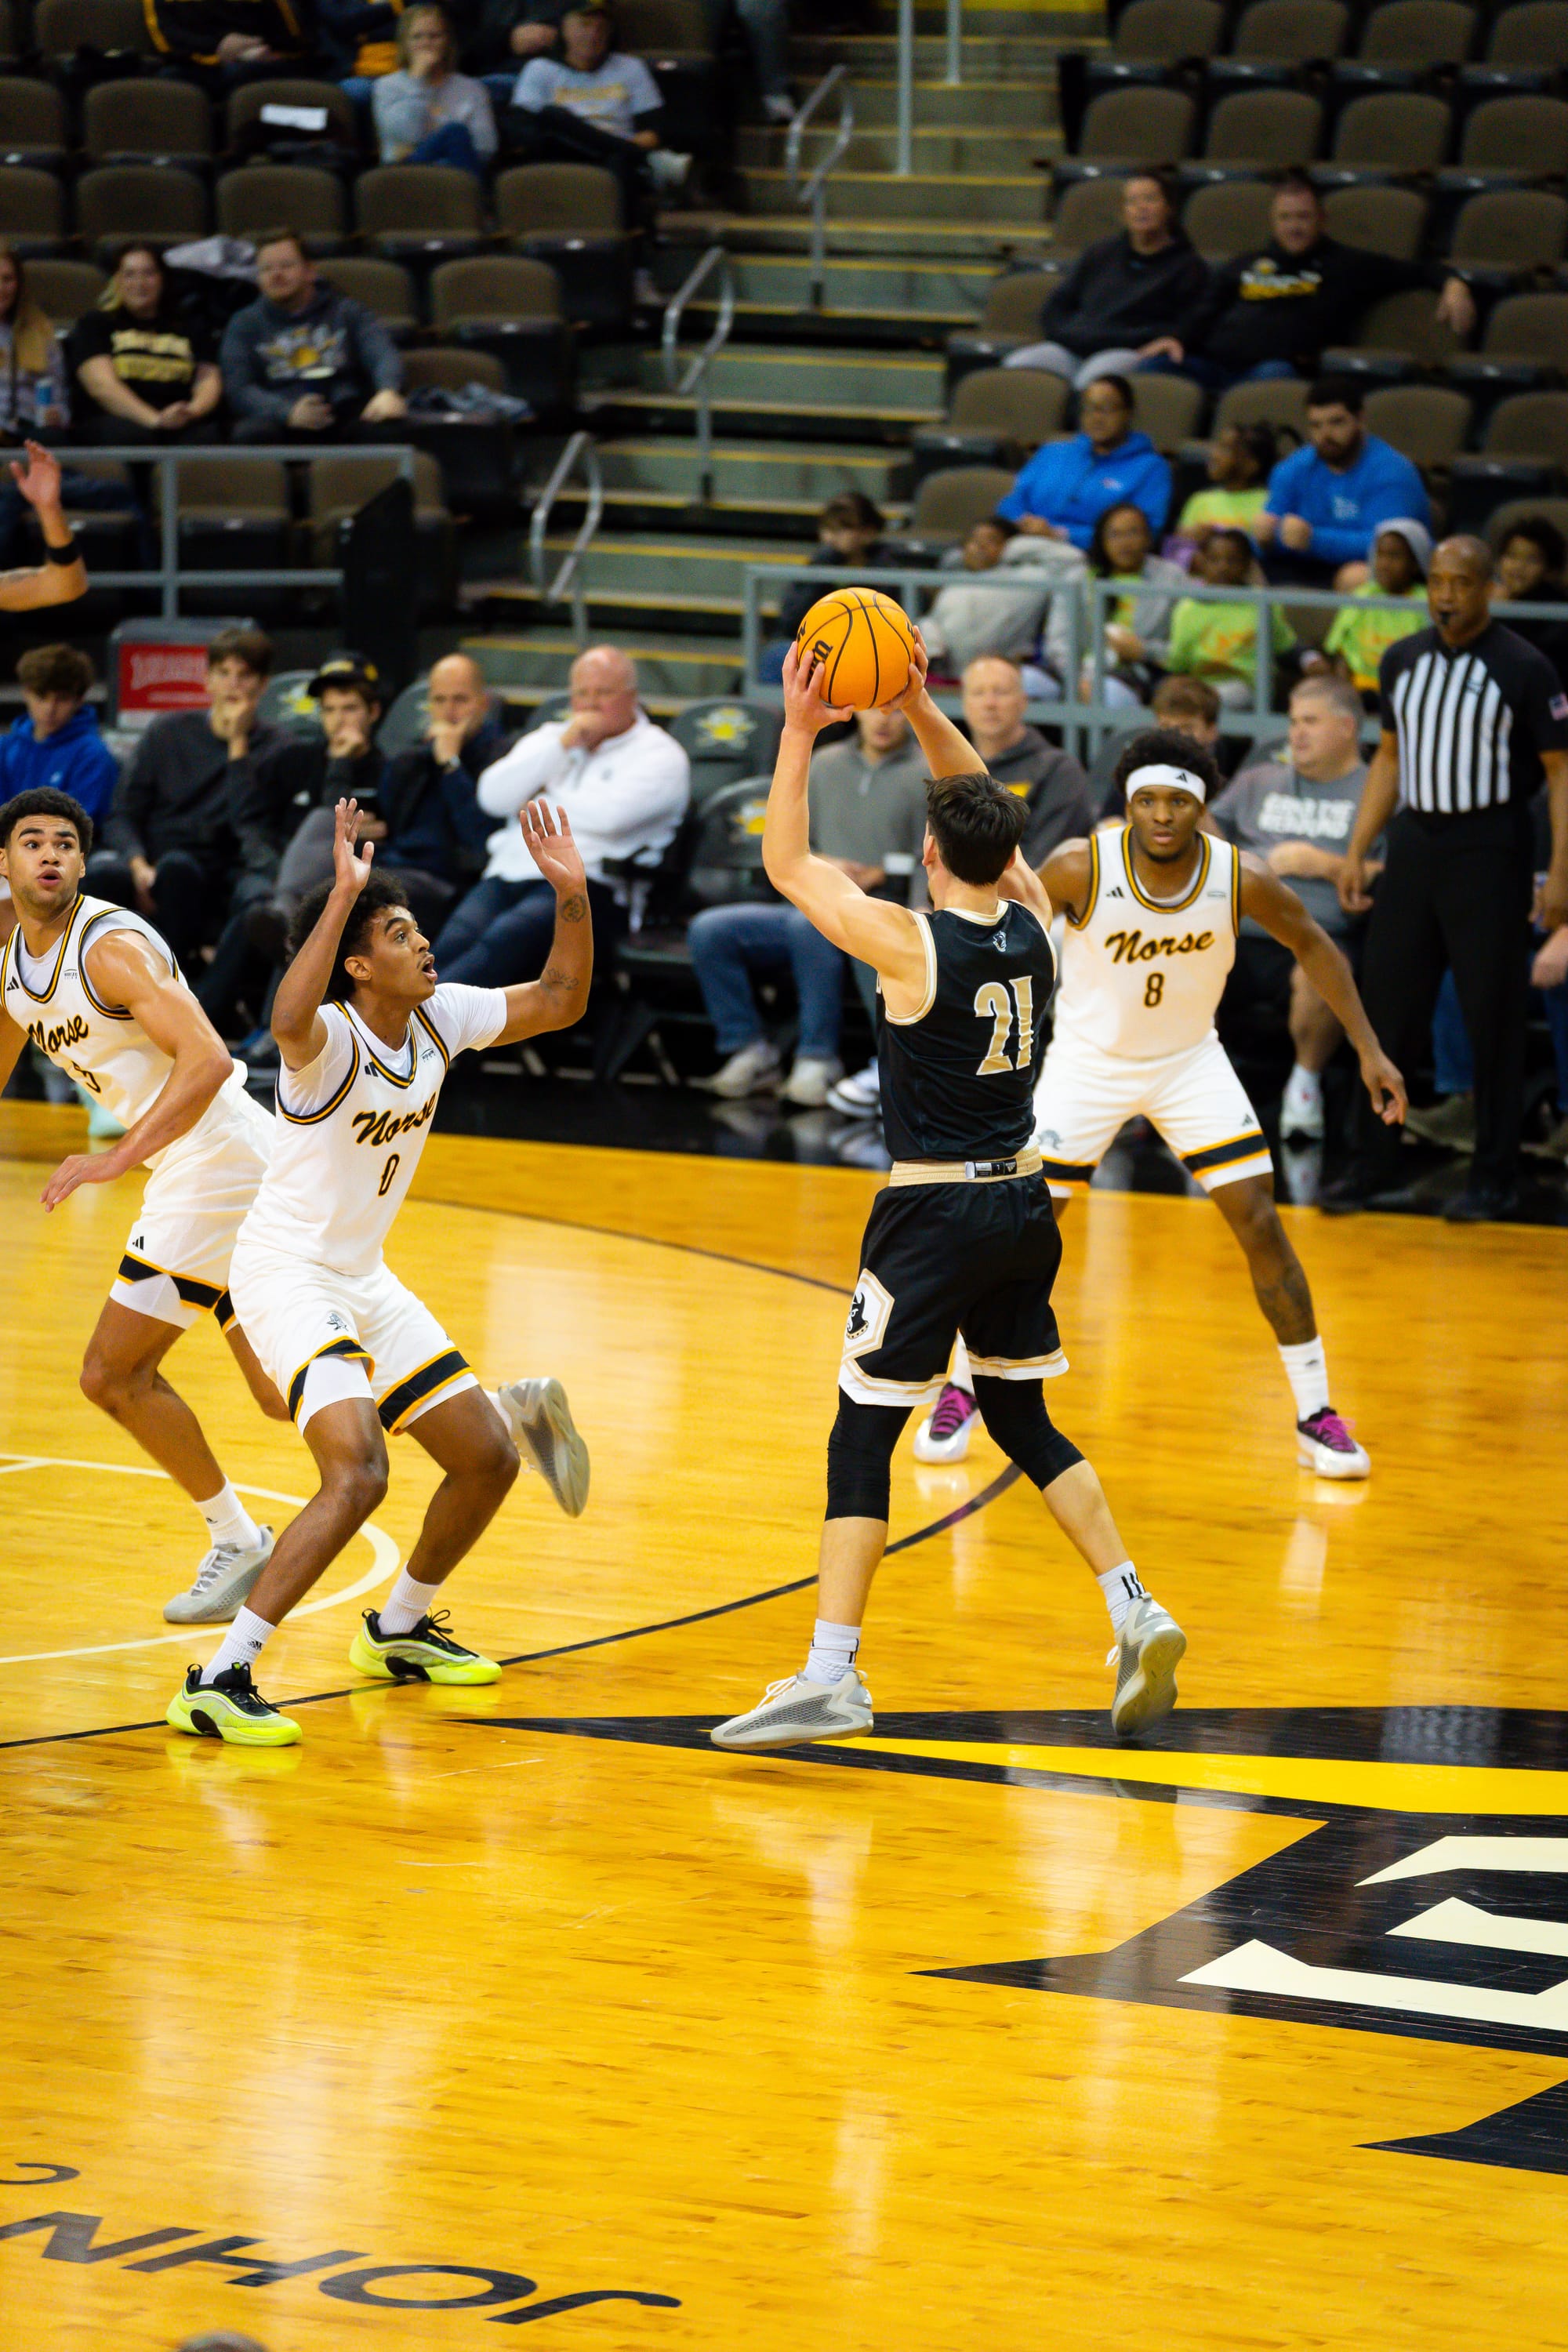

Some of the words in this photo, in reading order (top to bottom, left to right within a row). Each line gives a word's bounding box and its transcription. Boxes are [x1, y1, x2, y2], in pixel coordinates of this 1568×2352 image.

[1104, 928, 1215, 964] Norse
[1143, 971, 1165, 1007] 8
[27, 1014, 89, 1053] Norse
[974, 975, 1034, 1075] 21
[352, 1091, 437, 1146] Norse
[377, 1153, 401, 1196] 0
[0, 2211, 682, 2325] JOHN
